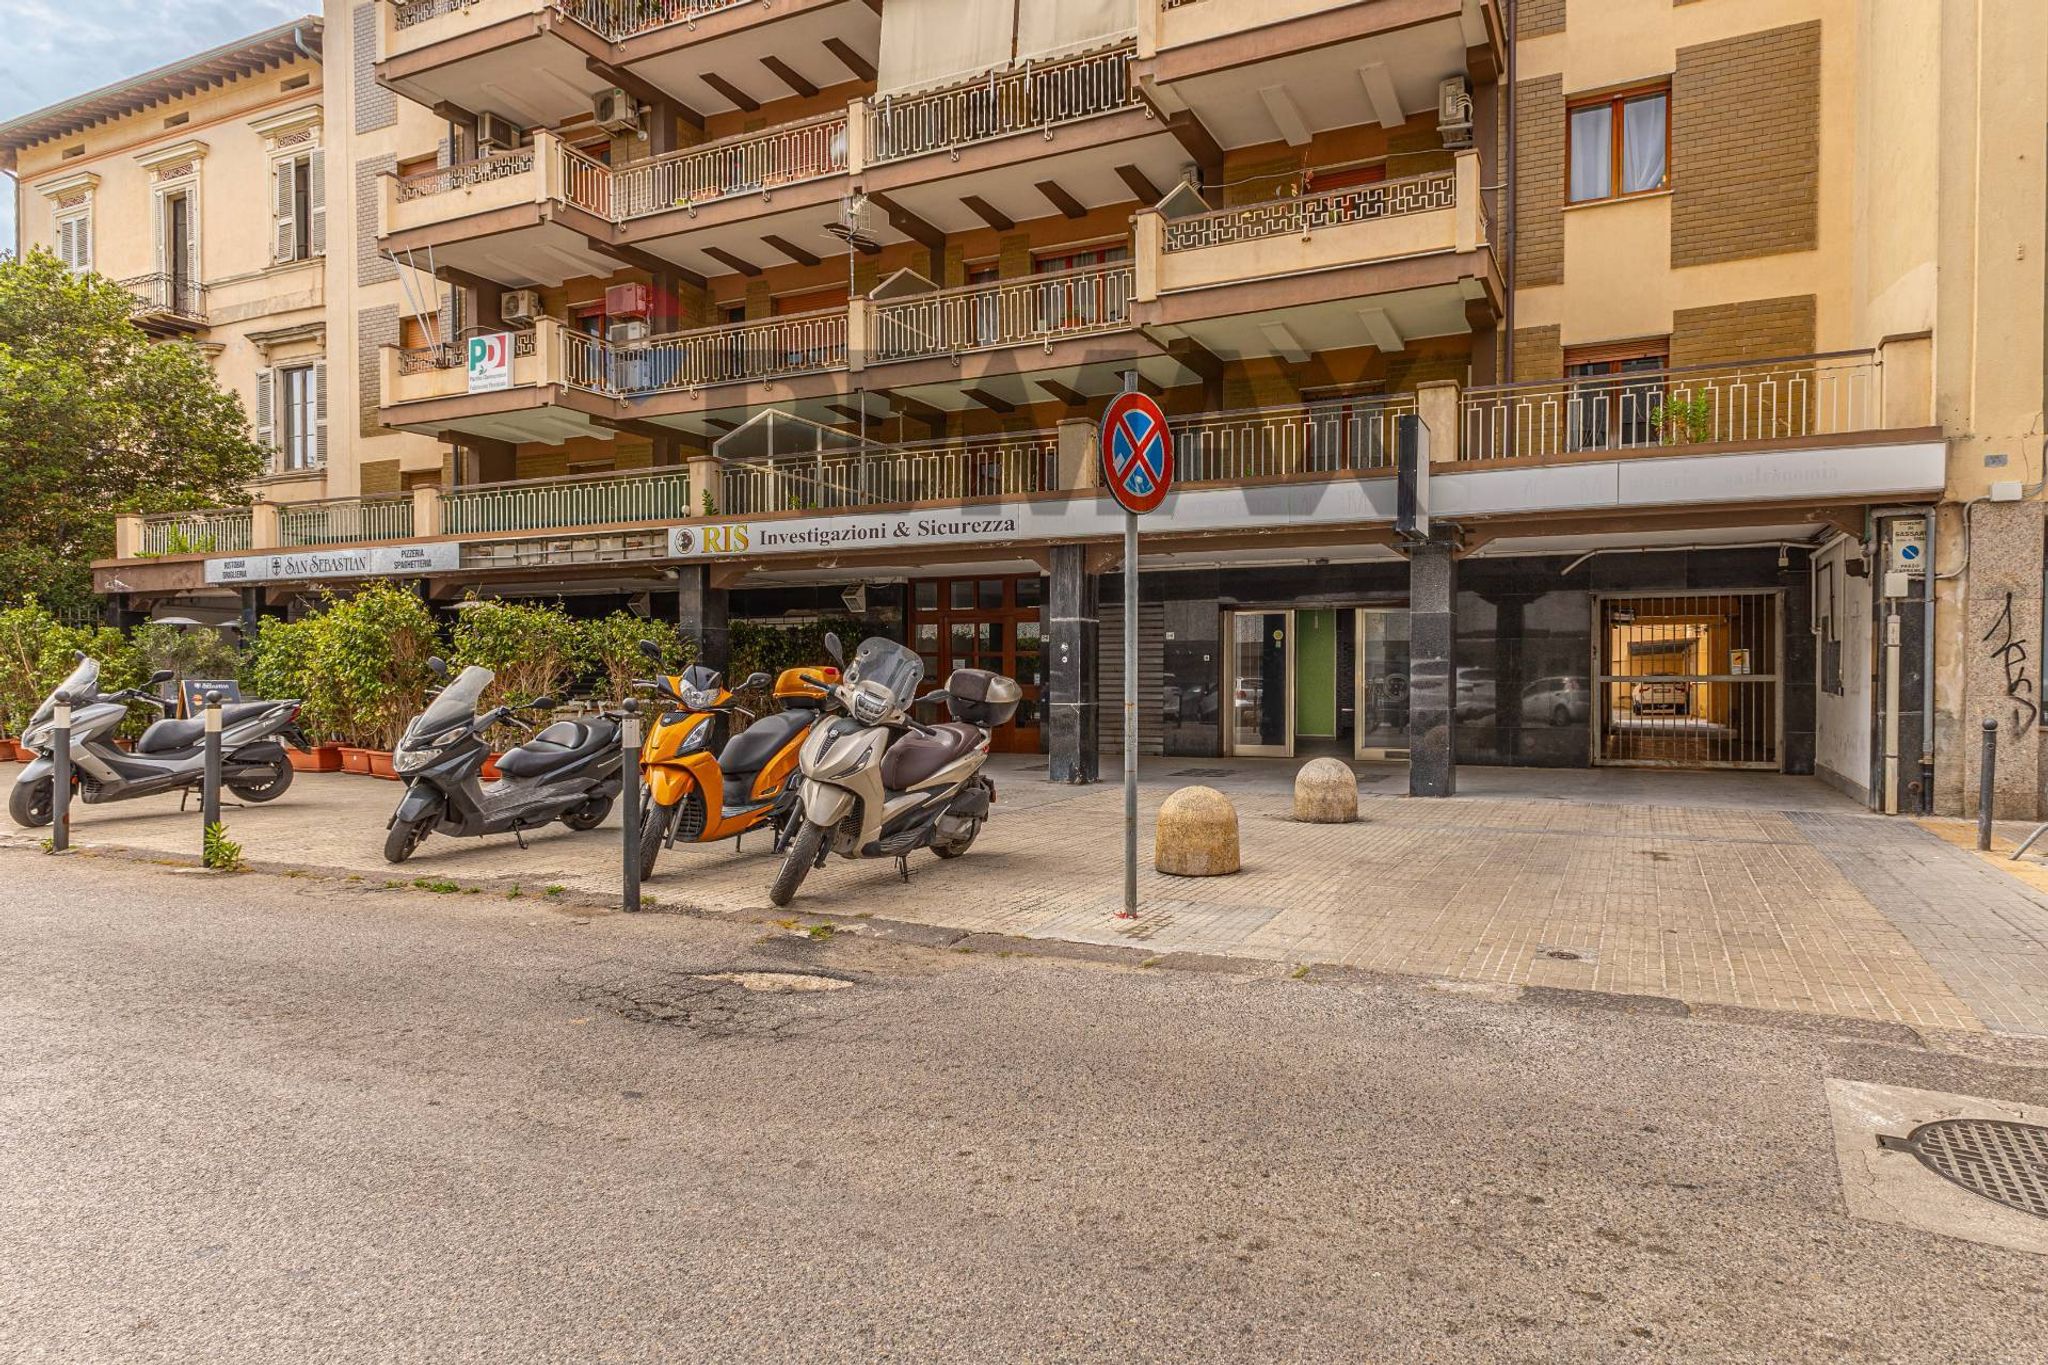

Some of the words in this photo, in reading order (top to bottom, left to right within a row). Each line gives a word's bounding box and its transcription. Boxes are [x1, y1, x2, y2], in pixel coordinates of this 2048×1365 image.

[470, 336, 506, 371] PD
[701, 524, 749, 553] RIS
[760, 522, 886, 546] Investigazioni
[892, 521, 911, 538] &
[917, 517, 1016, 537] Sicurezza
[285, 557, 308, 575] SAN
[309, 555, 366, 573] SEBASTIAN
[401, 548, 424, 558] PIZZERIA
